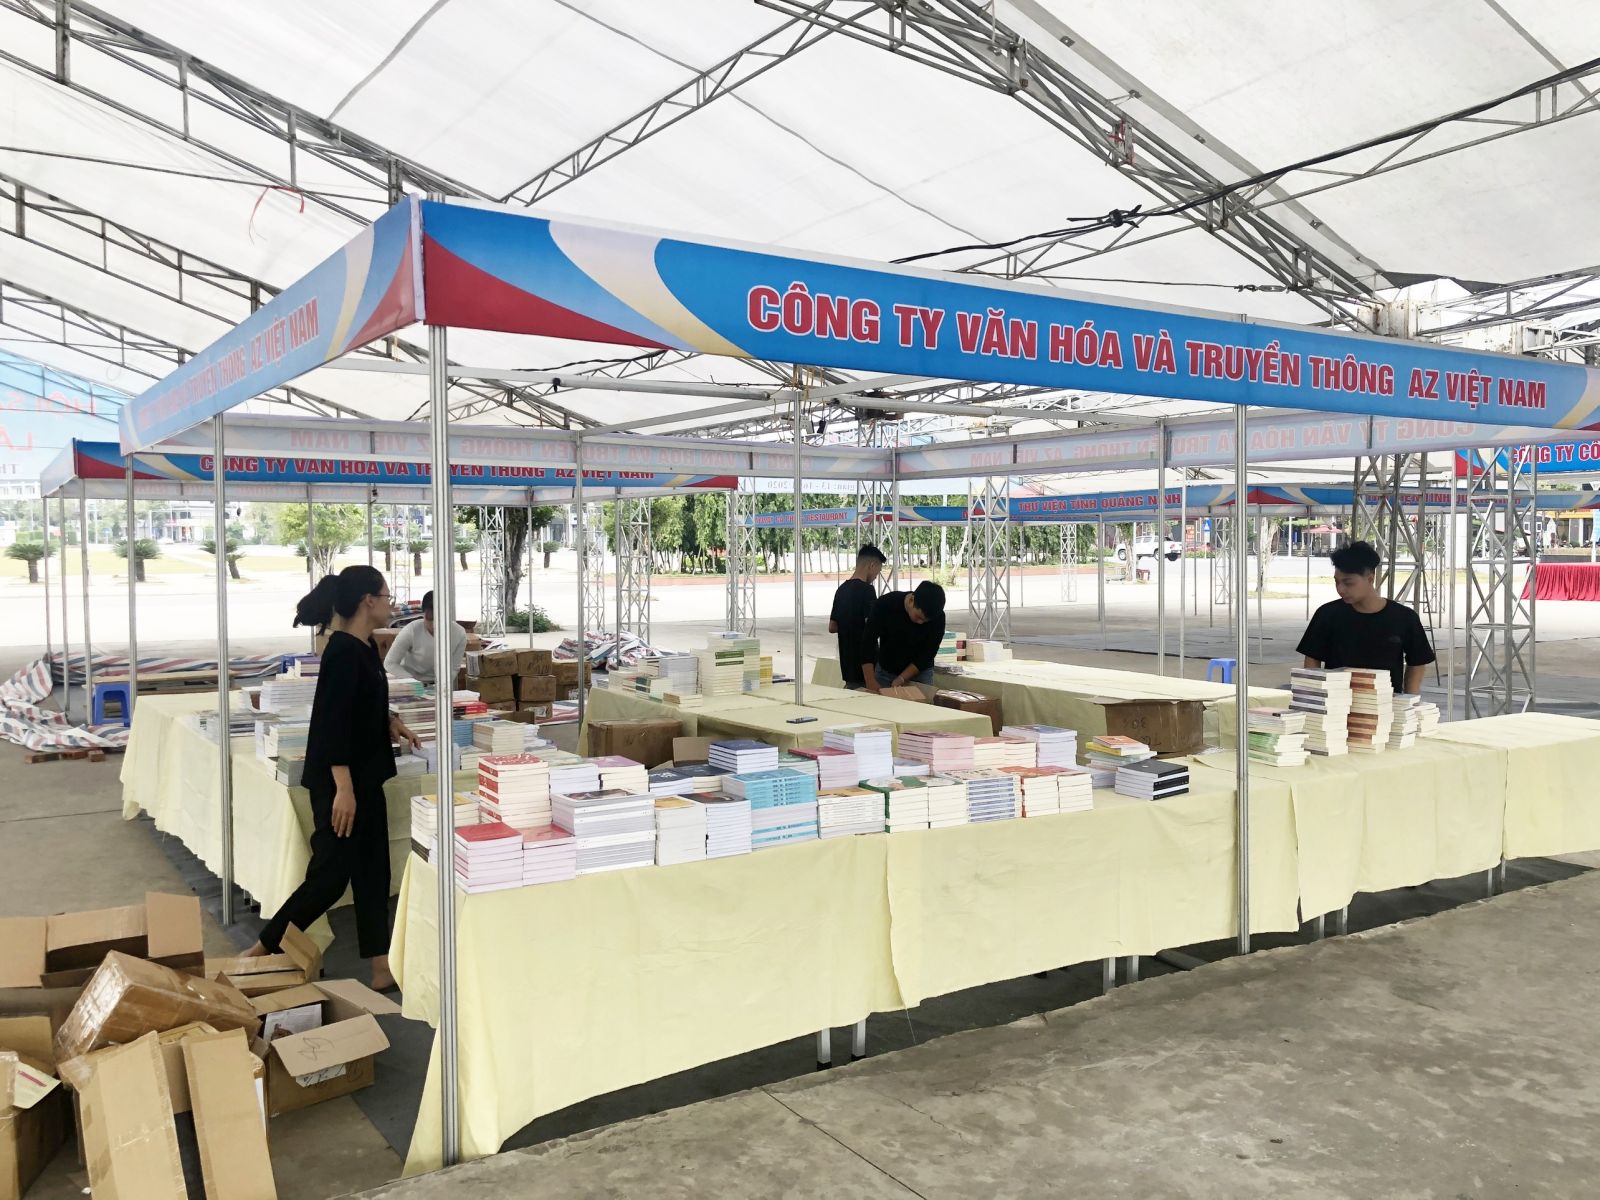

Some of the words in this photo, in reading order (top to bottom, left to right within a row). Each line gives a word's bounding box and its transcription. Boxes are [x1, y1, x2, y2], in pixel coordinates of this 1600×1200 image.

[262, 313, 287, 368] VIỆT
[289, 296, 320, 352] NAM
[747, 281, 882, 344] CÔNG
[893, 303, 946, 350] TY
[956, 307, 1038, 361] VĂN
[1048, 320, 1123, 370] HÓA
[1132, 329, 1177, 375] VÀ
[1185, 339, 1301, 387] TRUYỀN
[1308, 354, 1395, 397] THÔNG
[1407, 367, 1440, 401] AZ
[1444, 367, 1493, 410] VIỆT
[1498, 380, 1547, 410] NAM
[264, 457, 289, 474] TY
[1555, 445, 1575, 463] TY
